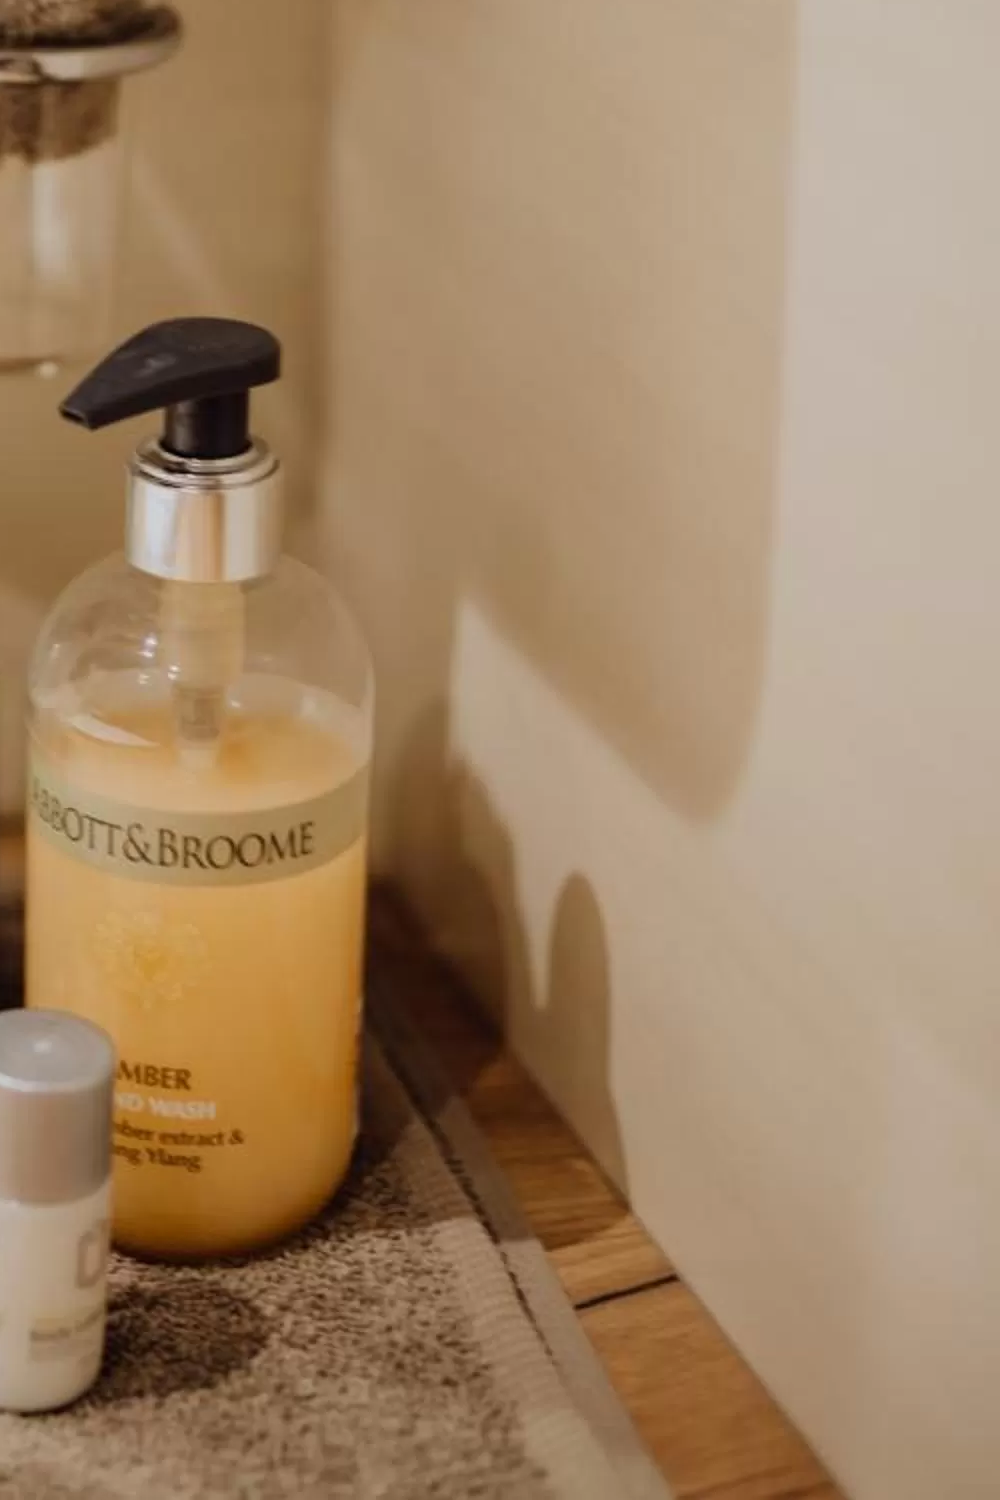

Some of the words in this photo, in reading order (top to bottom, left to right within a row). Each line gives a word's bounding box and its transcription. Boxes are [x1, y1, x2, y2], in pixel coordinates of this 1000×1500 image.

[148, 1096, 217, 1120] WASH
[158, 1129, 225, 1146] extract
[228, 1128, 244, 1145] &
